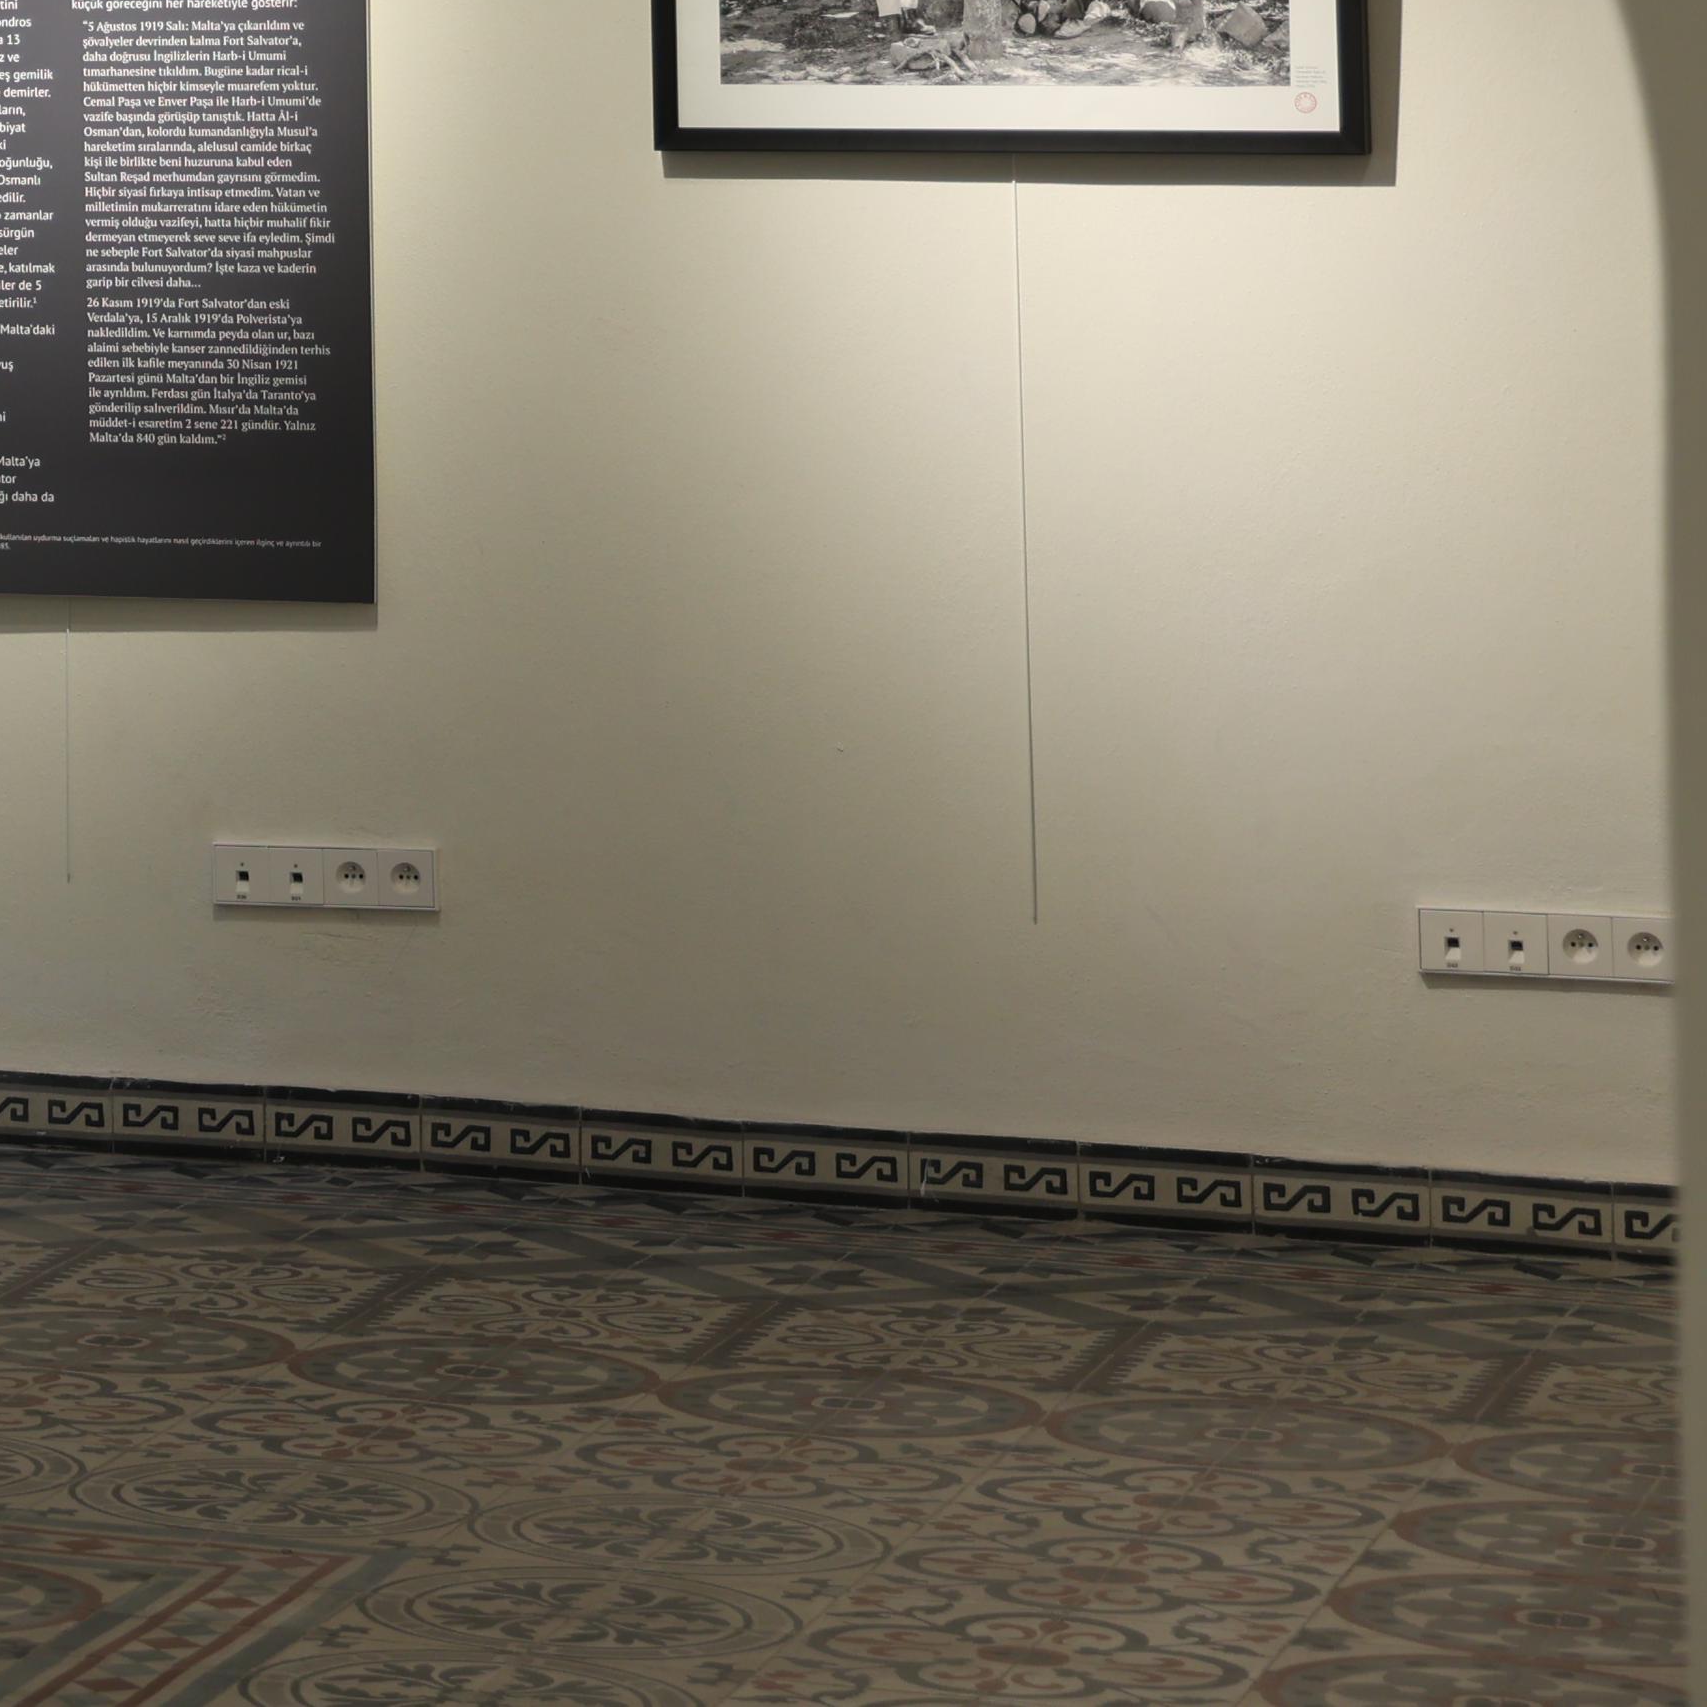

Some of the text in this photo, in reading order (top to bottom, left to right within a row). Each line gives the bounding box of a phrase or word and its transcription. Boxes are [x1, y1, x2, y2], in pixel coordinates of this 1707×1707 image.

[84, 156, 293, 169] kişi ile birlikte beni huzuruna kabul eden
[87, 357, 298, 371] edilen ilk kafile meyanında 30 Nisan 1921
